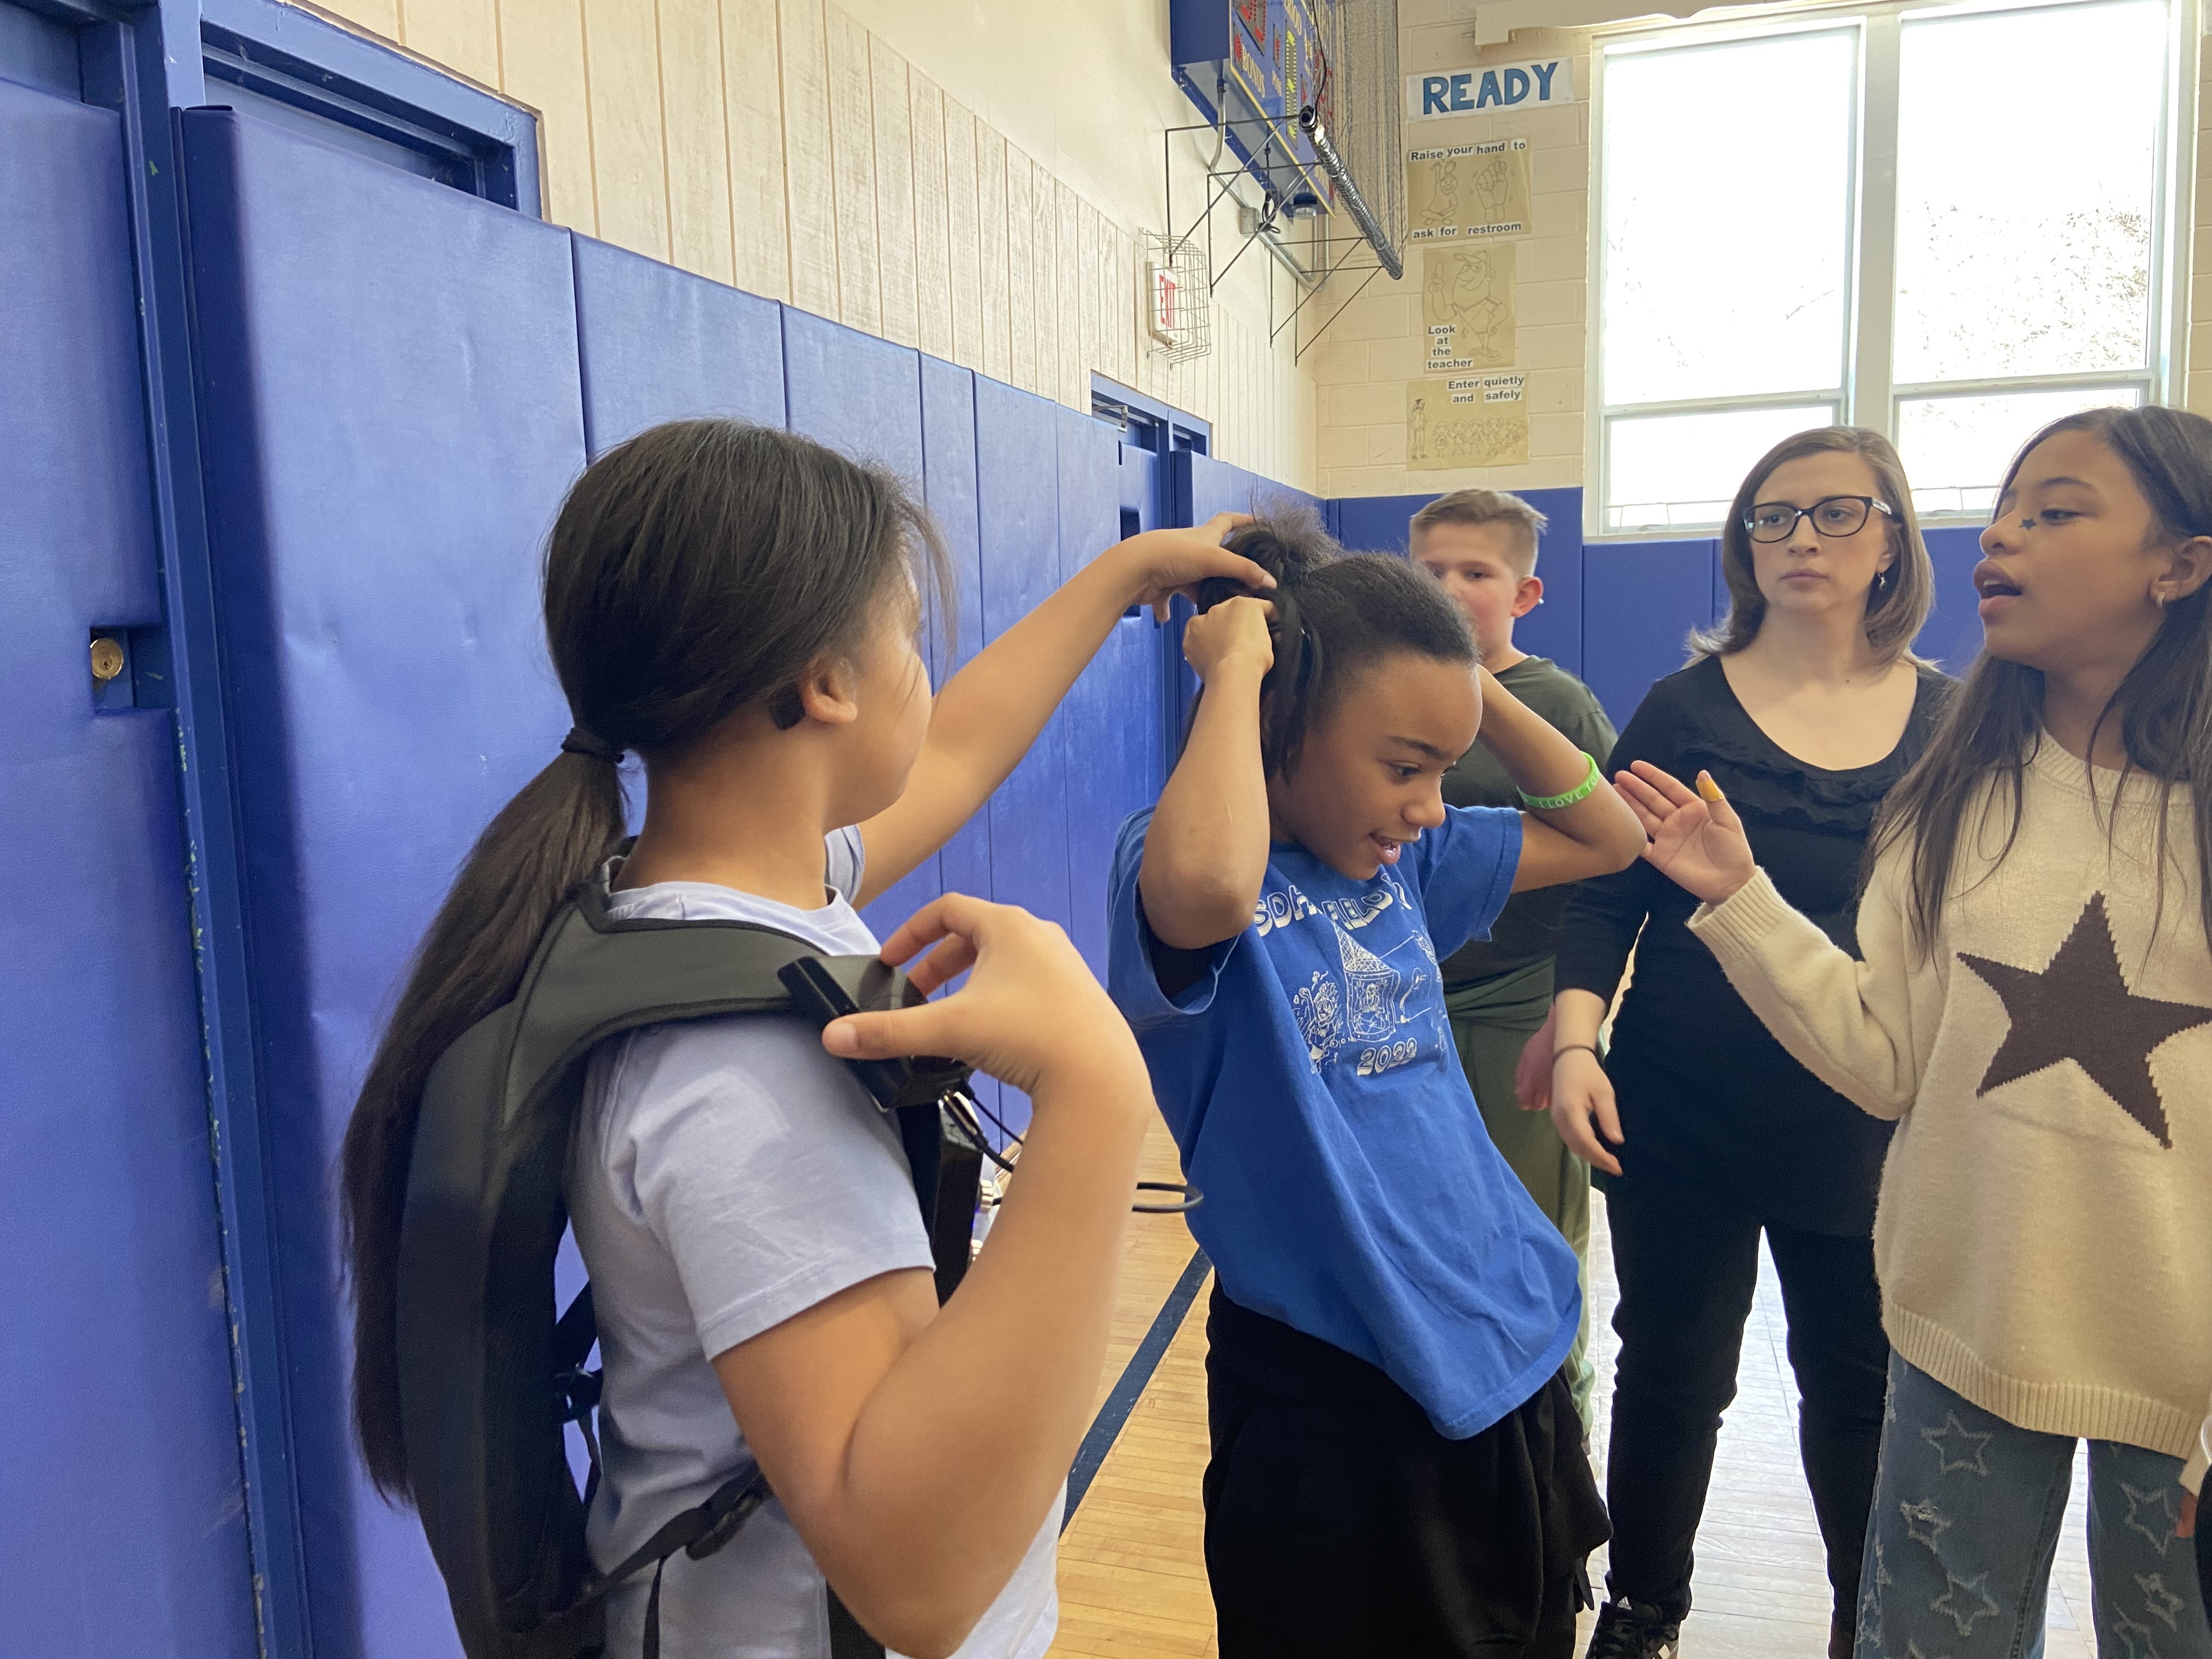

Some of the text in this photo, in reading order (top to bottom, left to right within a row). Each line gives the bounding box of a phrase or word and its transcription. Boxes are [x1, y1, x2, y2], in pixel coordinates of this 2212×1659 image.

[1242, 44, 1265, 98] BONUS
[1423, 61, 1559, 115] READY
[1411, 142, 1526, 161] Raise your hand to
[1413, 222, 1521, 239] ask for restroom
[1159, 274, 1176, 329] EXIT
[1429, 325, 1456, 335] Look
[1436, 336, 1448, 345] at
[1432, 347, 1451, 356] the
[1427, 359, 1472, 369] teacher
[1448, 376, 1525, 390] Enter quietly
[1453, 390, 1521, 403] and safely
[1548, 792, 1583, 809] LOVE
[1357, 1037, 1418, 1076] 2022
